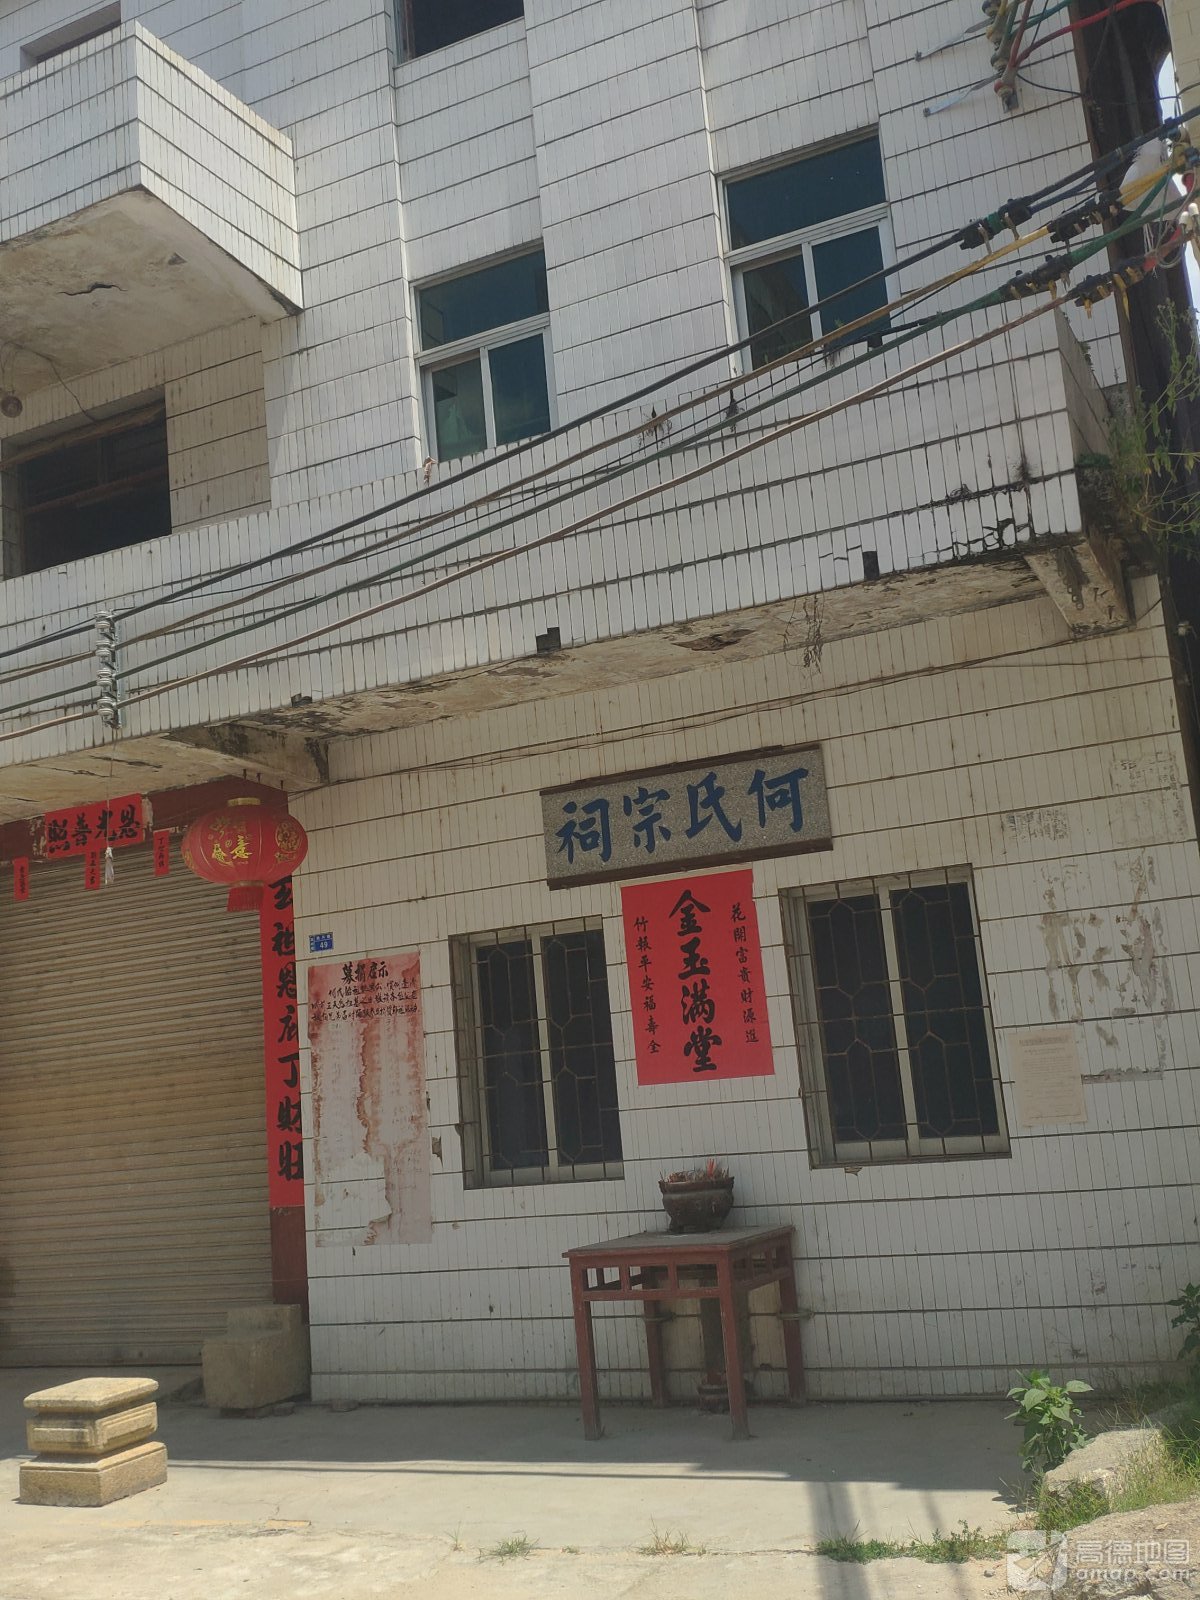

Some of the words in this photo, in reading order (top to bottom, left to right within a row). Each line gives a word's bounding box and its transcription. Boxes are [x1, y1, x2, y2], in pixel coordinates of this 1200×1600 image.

[555, 767, 809, 864] 何氏宗祠
[319, 941, 328, 949] 49
[633, 915, 661, 1054] 竹報平安福壽全
